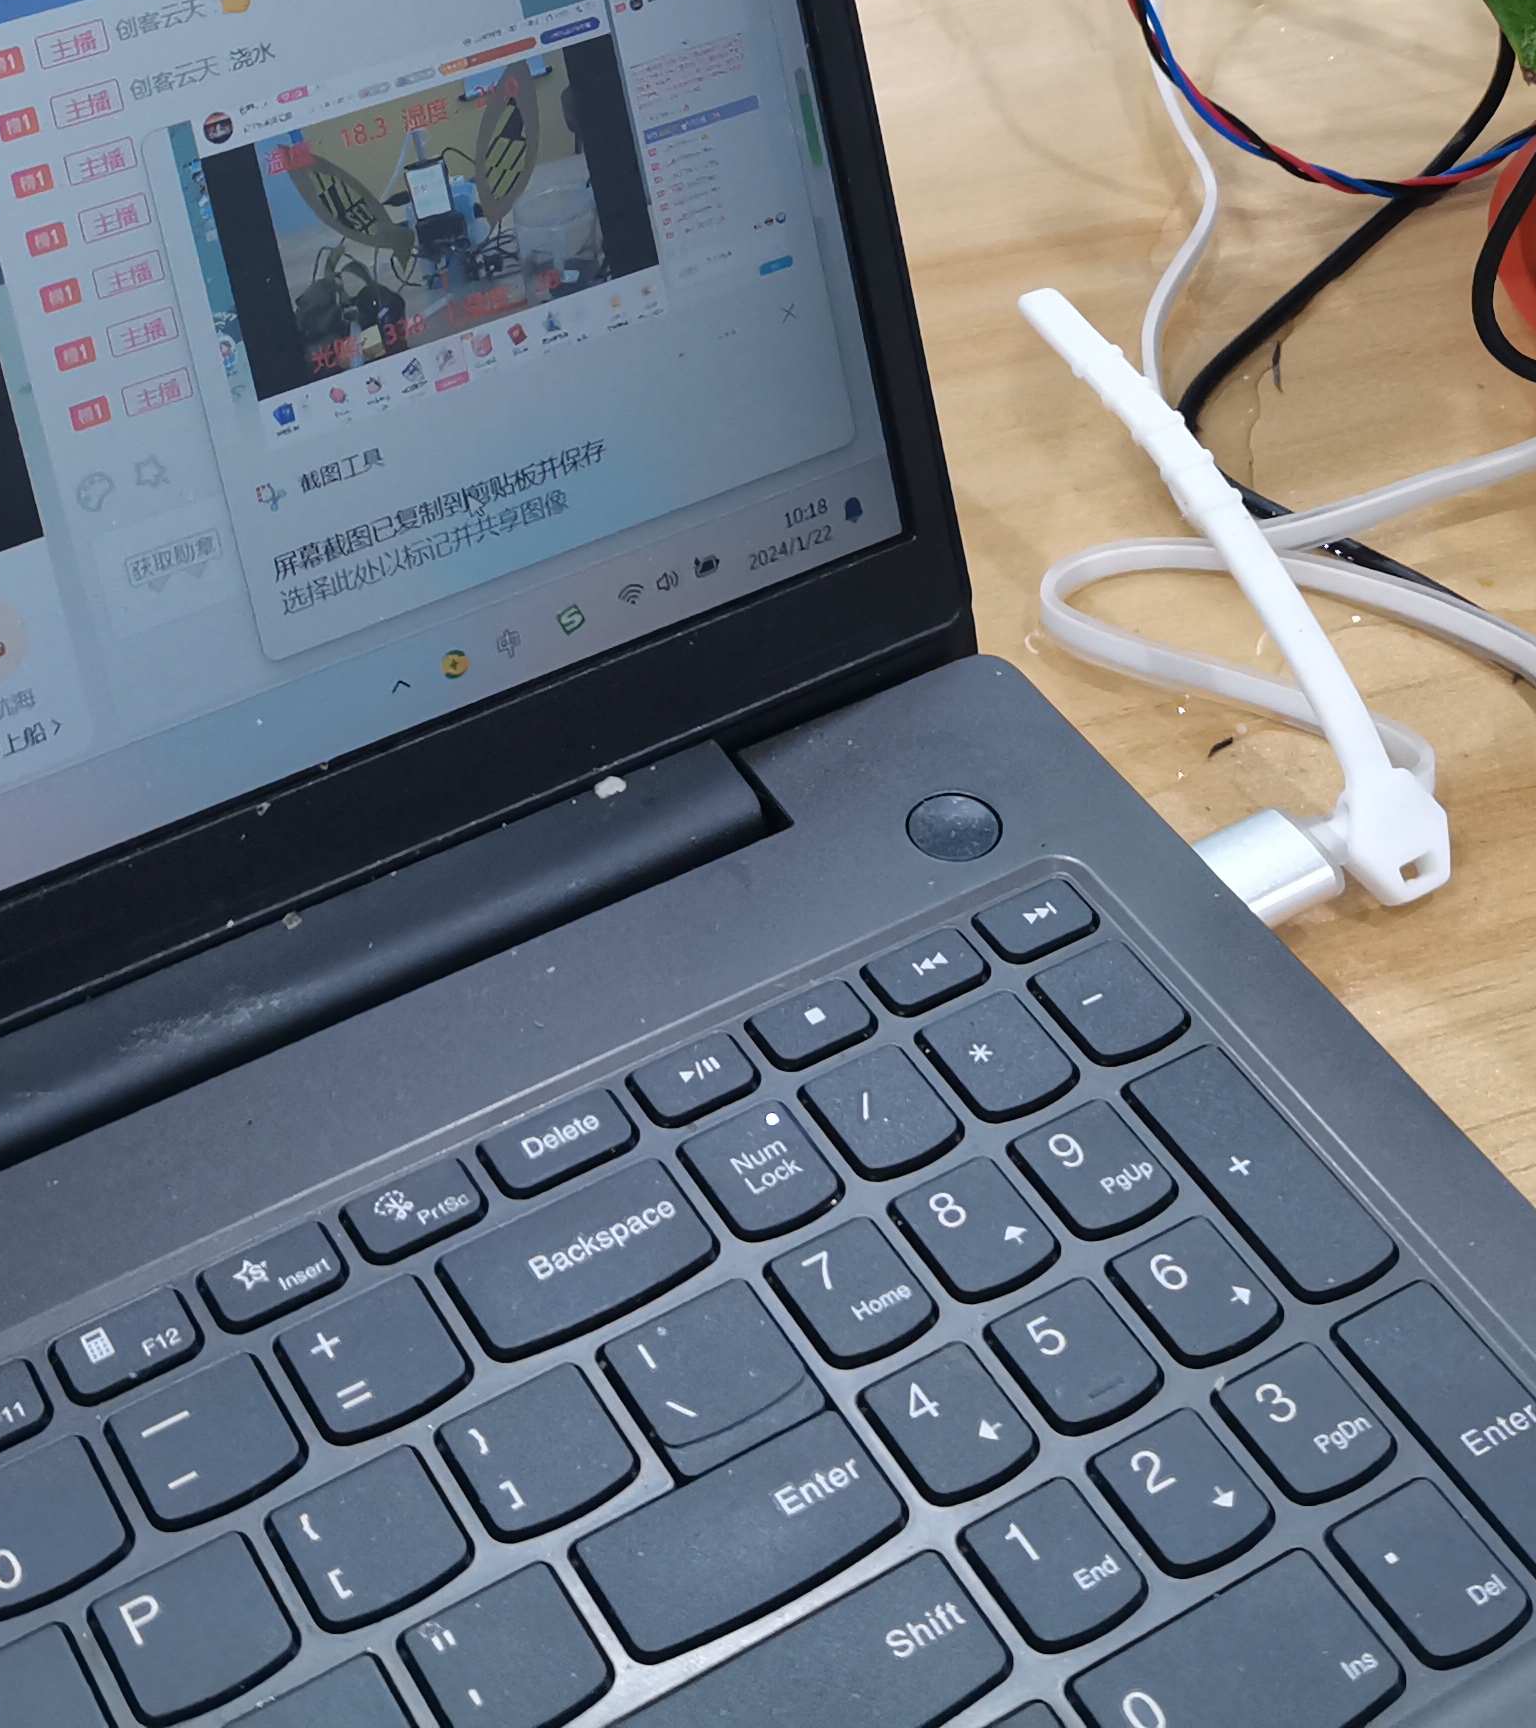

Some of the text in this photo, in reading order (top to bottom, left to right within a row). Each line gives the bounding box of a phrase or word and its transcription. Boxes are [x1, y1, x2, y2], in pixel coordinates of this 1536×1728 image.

[50, 30, 97, 63] 主播
[65, 90, 112, 122] 主播
[130, 56, 221, 101] 创客云天
[341, 117, 388, 148] 18.3
[79, 148, 126, 179] 主播
[94, 203, 140, 236] 主播
[108, 261, 154, 294] 主播
[120, 317, 167, 351] 主播
[299, 448, 385, 494] 截图工具
[784, 498, 828, 529] 10:18
[280, 489, 569, 616] 选择此处以标记并共享图像
[748, 525, 832, 571] 2024/1/22
[521, 1113, 600, 1160] Delete
[1047, 1133, 1085, 1168] 9
[730, 1137, 788, 1176] Num
[744, 1158, 804, 1196] Lock
[1100, 1160, 1155, 1196] PgUp
[417, 1191, 472, 1227] PrtSc
[928, 1192, 967, 1229] 8
[529, 1198, 676, 1282] Backspace
[278, 1256, 331, 1291] Insert
[801, 1250, 835, 1291] 7
[1149, 1253, 1188, 1290] 6
[851, 1283, 913, 1324] Home
[142, 1327, 184, 1357] F12
[1027, 1315, 1067, 1357] 5
[907, 1382, 941, 1421] 4
[1254, 1382, 1298, 1424] 3
[1312, 1413, 1373, 1458] PgDn
[772, 1459, 862, 1517] Enter
[1130, 1448, 1176, 1495] 2
[1004, 1523, 1041, 1563] 1
[1072, 1554, 1121, 1593] End
[1467, 1574, 1508, 1607] Del
[119, 1594, 160, 1646] P
[885, 1601, 966, 1660] Shift
[1340, 1652, 1379, 1681] Ins
[1121, 1691, 1165, 1728] 0
